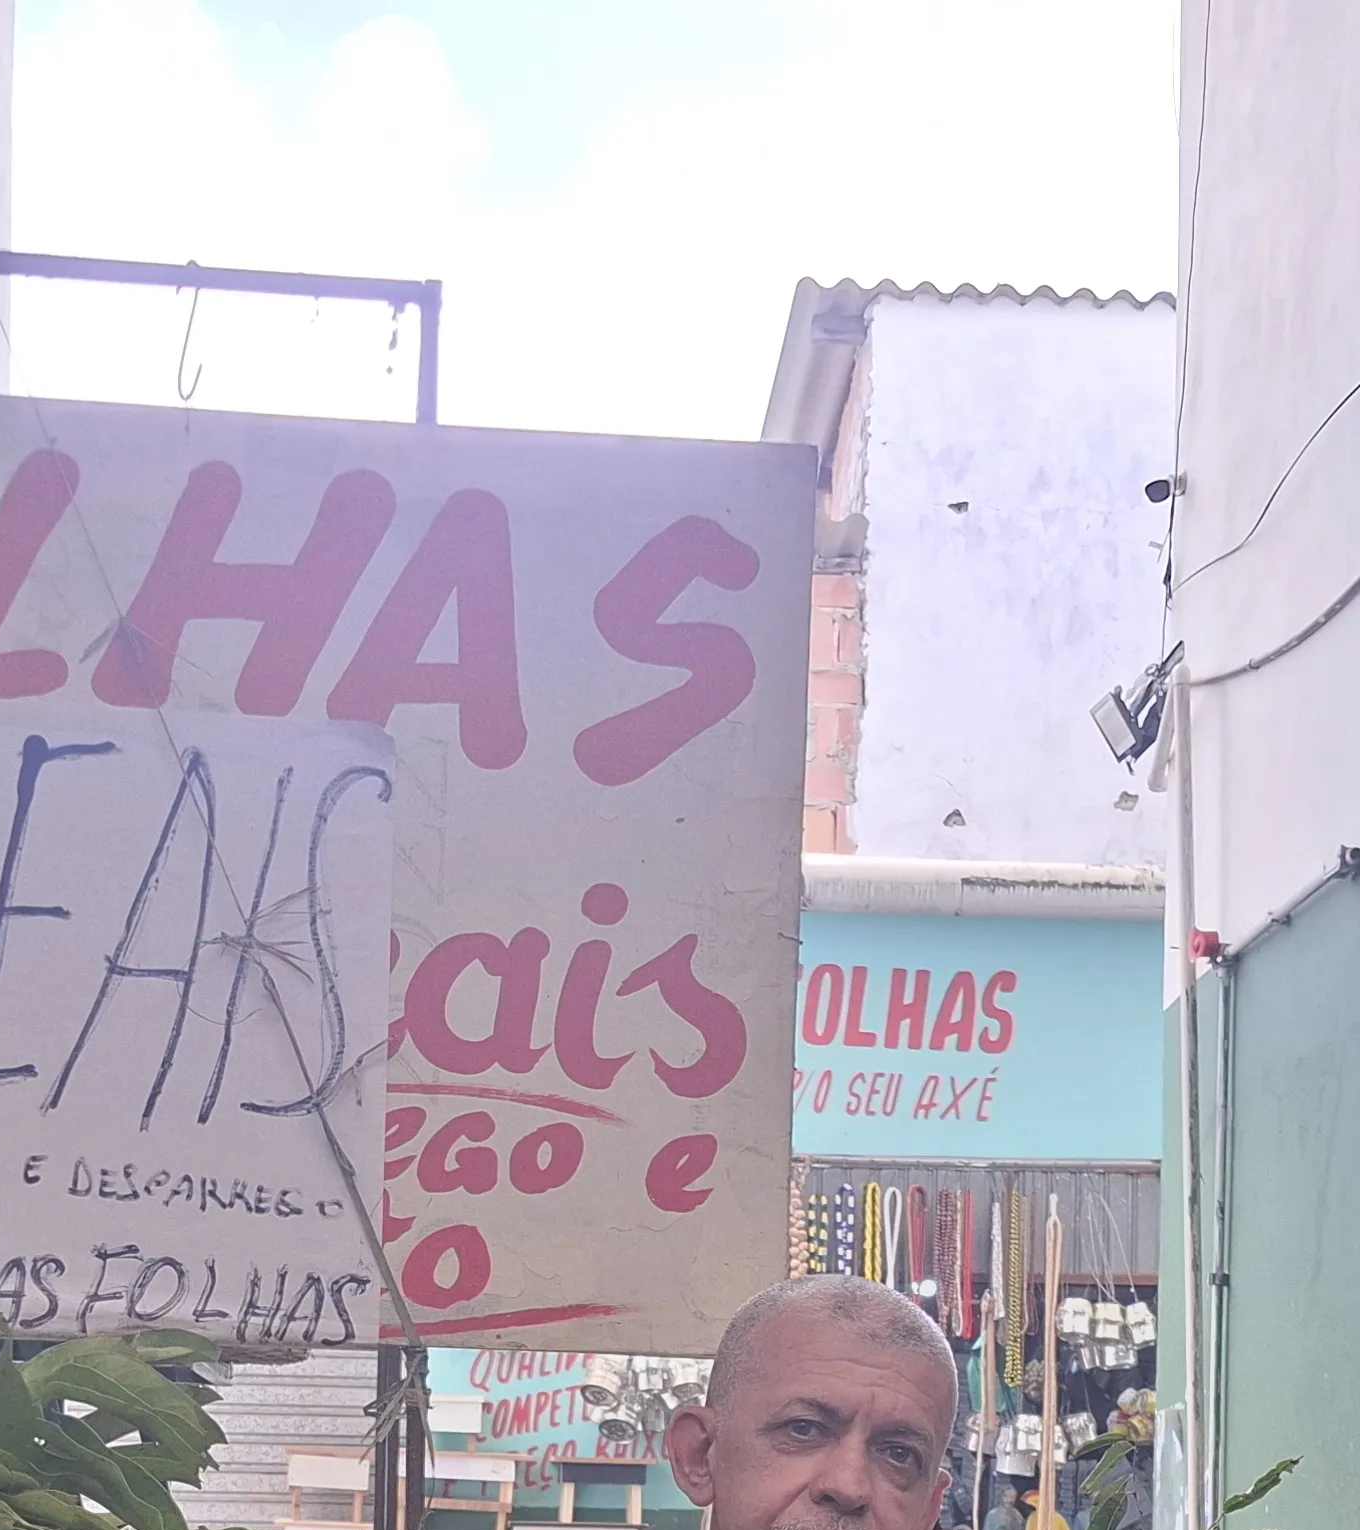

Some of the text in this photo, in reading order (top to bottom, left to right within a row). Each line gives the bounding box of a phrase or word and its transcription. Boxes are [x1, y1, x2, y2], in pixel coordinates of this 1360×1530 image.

[388, 883, 748, 1098] ais
[797, 962, 1019, 1055] OLHAS
[845, 1071, 904, 1118] SEU
[913, 1066, 1001, 1122] AXÉ
[22, 1154, 50, 1186] E
[76, 1242, 373, 1345] FOLHAS
